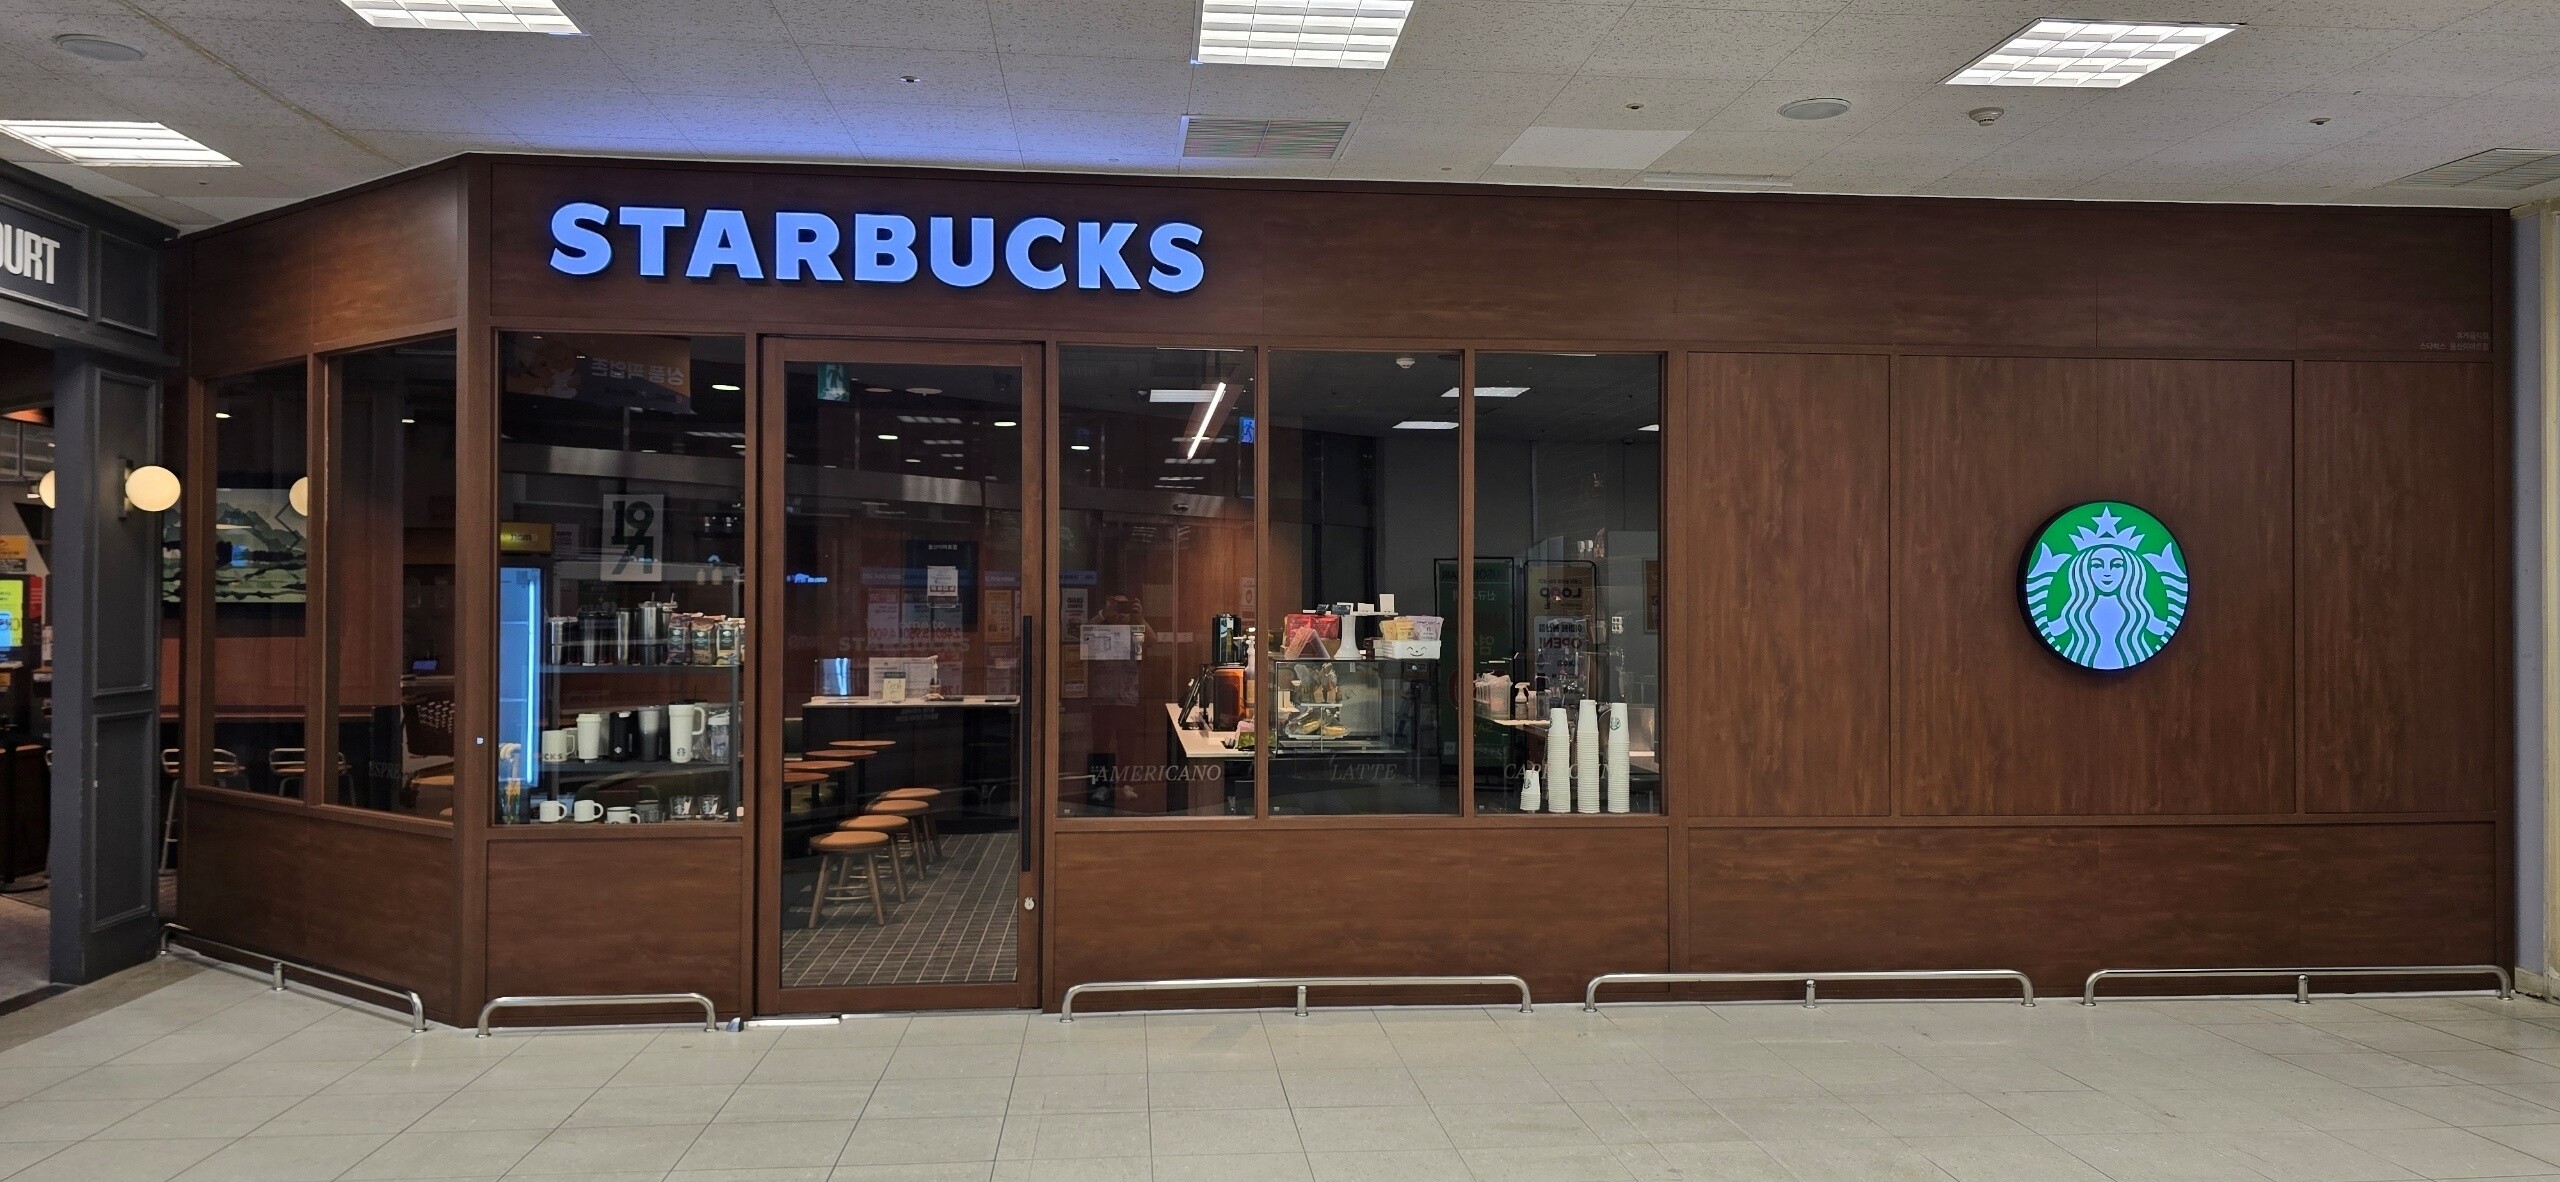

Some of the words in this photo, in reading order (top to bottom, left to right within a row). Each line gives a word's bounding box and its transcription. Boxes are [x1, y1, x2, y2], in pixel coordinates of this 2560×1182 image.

[0, 221, 61, 285] URT
[548, 202, 1206, 292] STARBUCKS
[2419, 342, 2446, 351] 스타벅스
[1095, 763, 1222, 782] AMERICANO
[1328, 763, 1398, 781] LATTE
